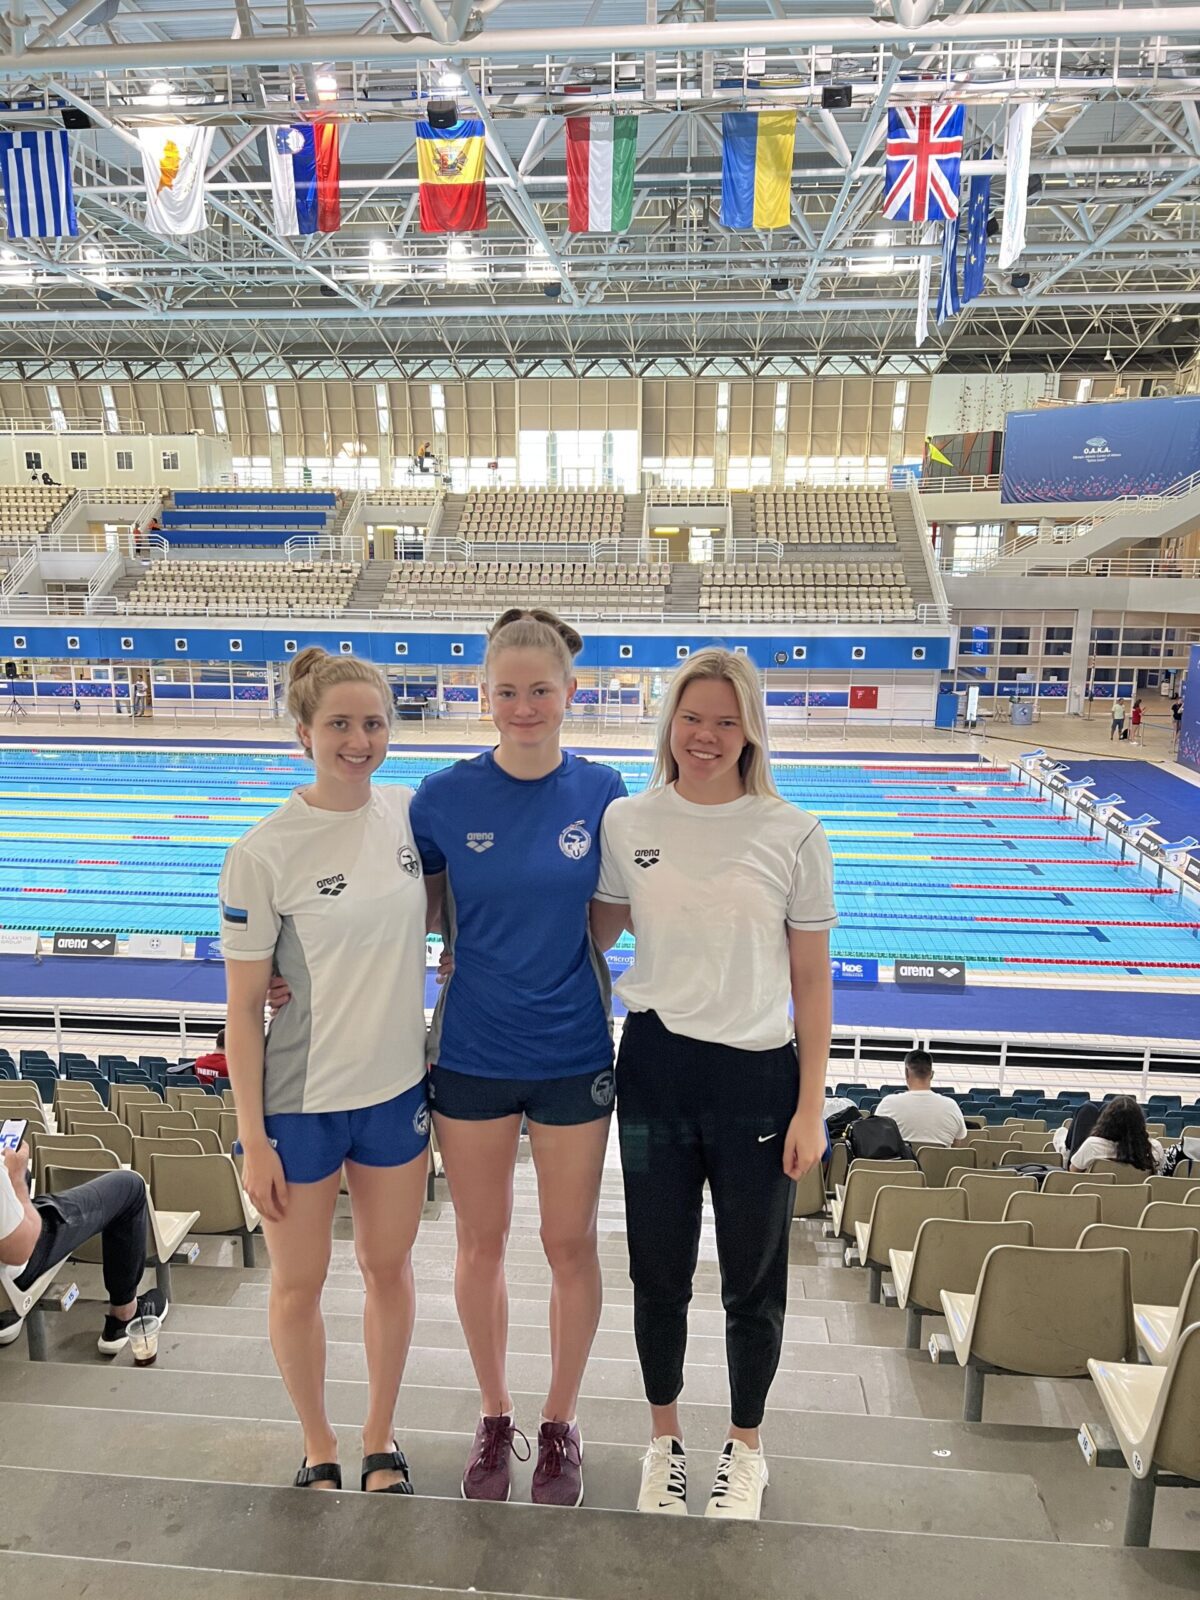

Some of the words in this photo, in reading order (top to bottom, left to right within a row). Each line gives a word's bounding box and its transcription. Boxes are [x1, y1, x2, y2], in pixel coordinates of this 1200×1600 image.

[466, 832, 494, 841] arena
[634, 848, 660, 857] arena
[316, 873, 345, 889] arena
[57, 938, 88, 949] arena
[900, 965, 934, 977] arena
[1083, 1437, 1089, 1450] 16
[1134, 1455, 1141, 1470] 16
